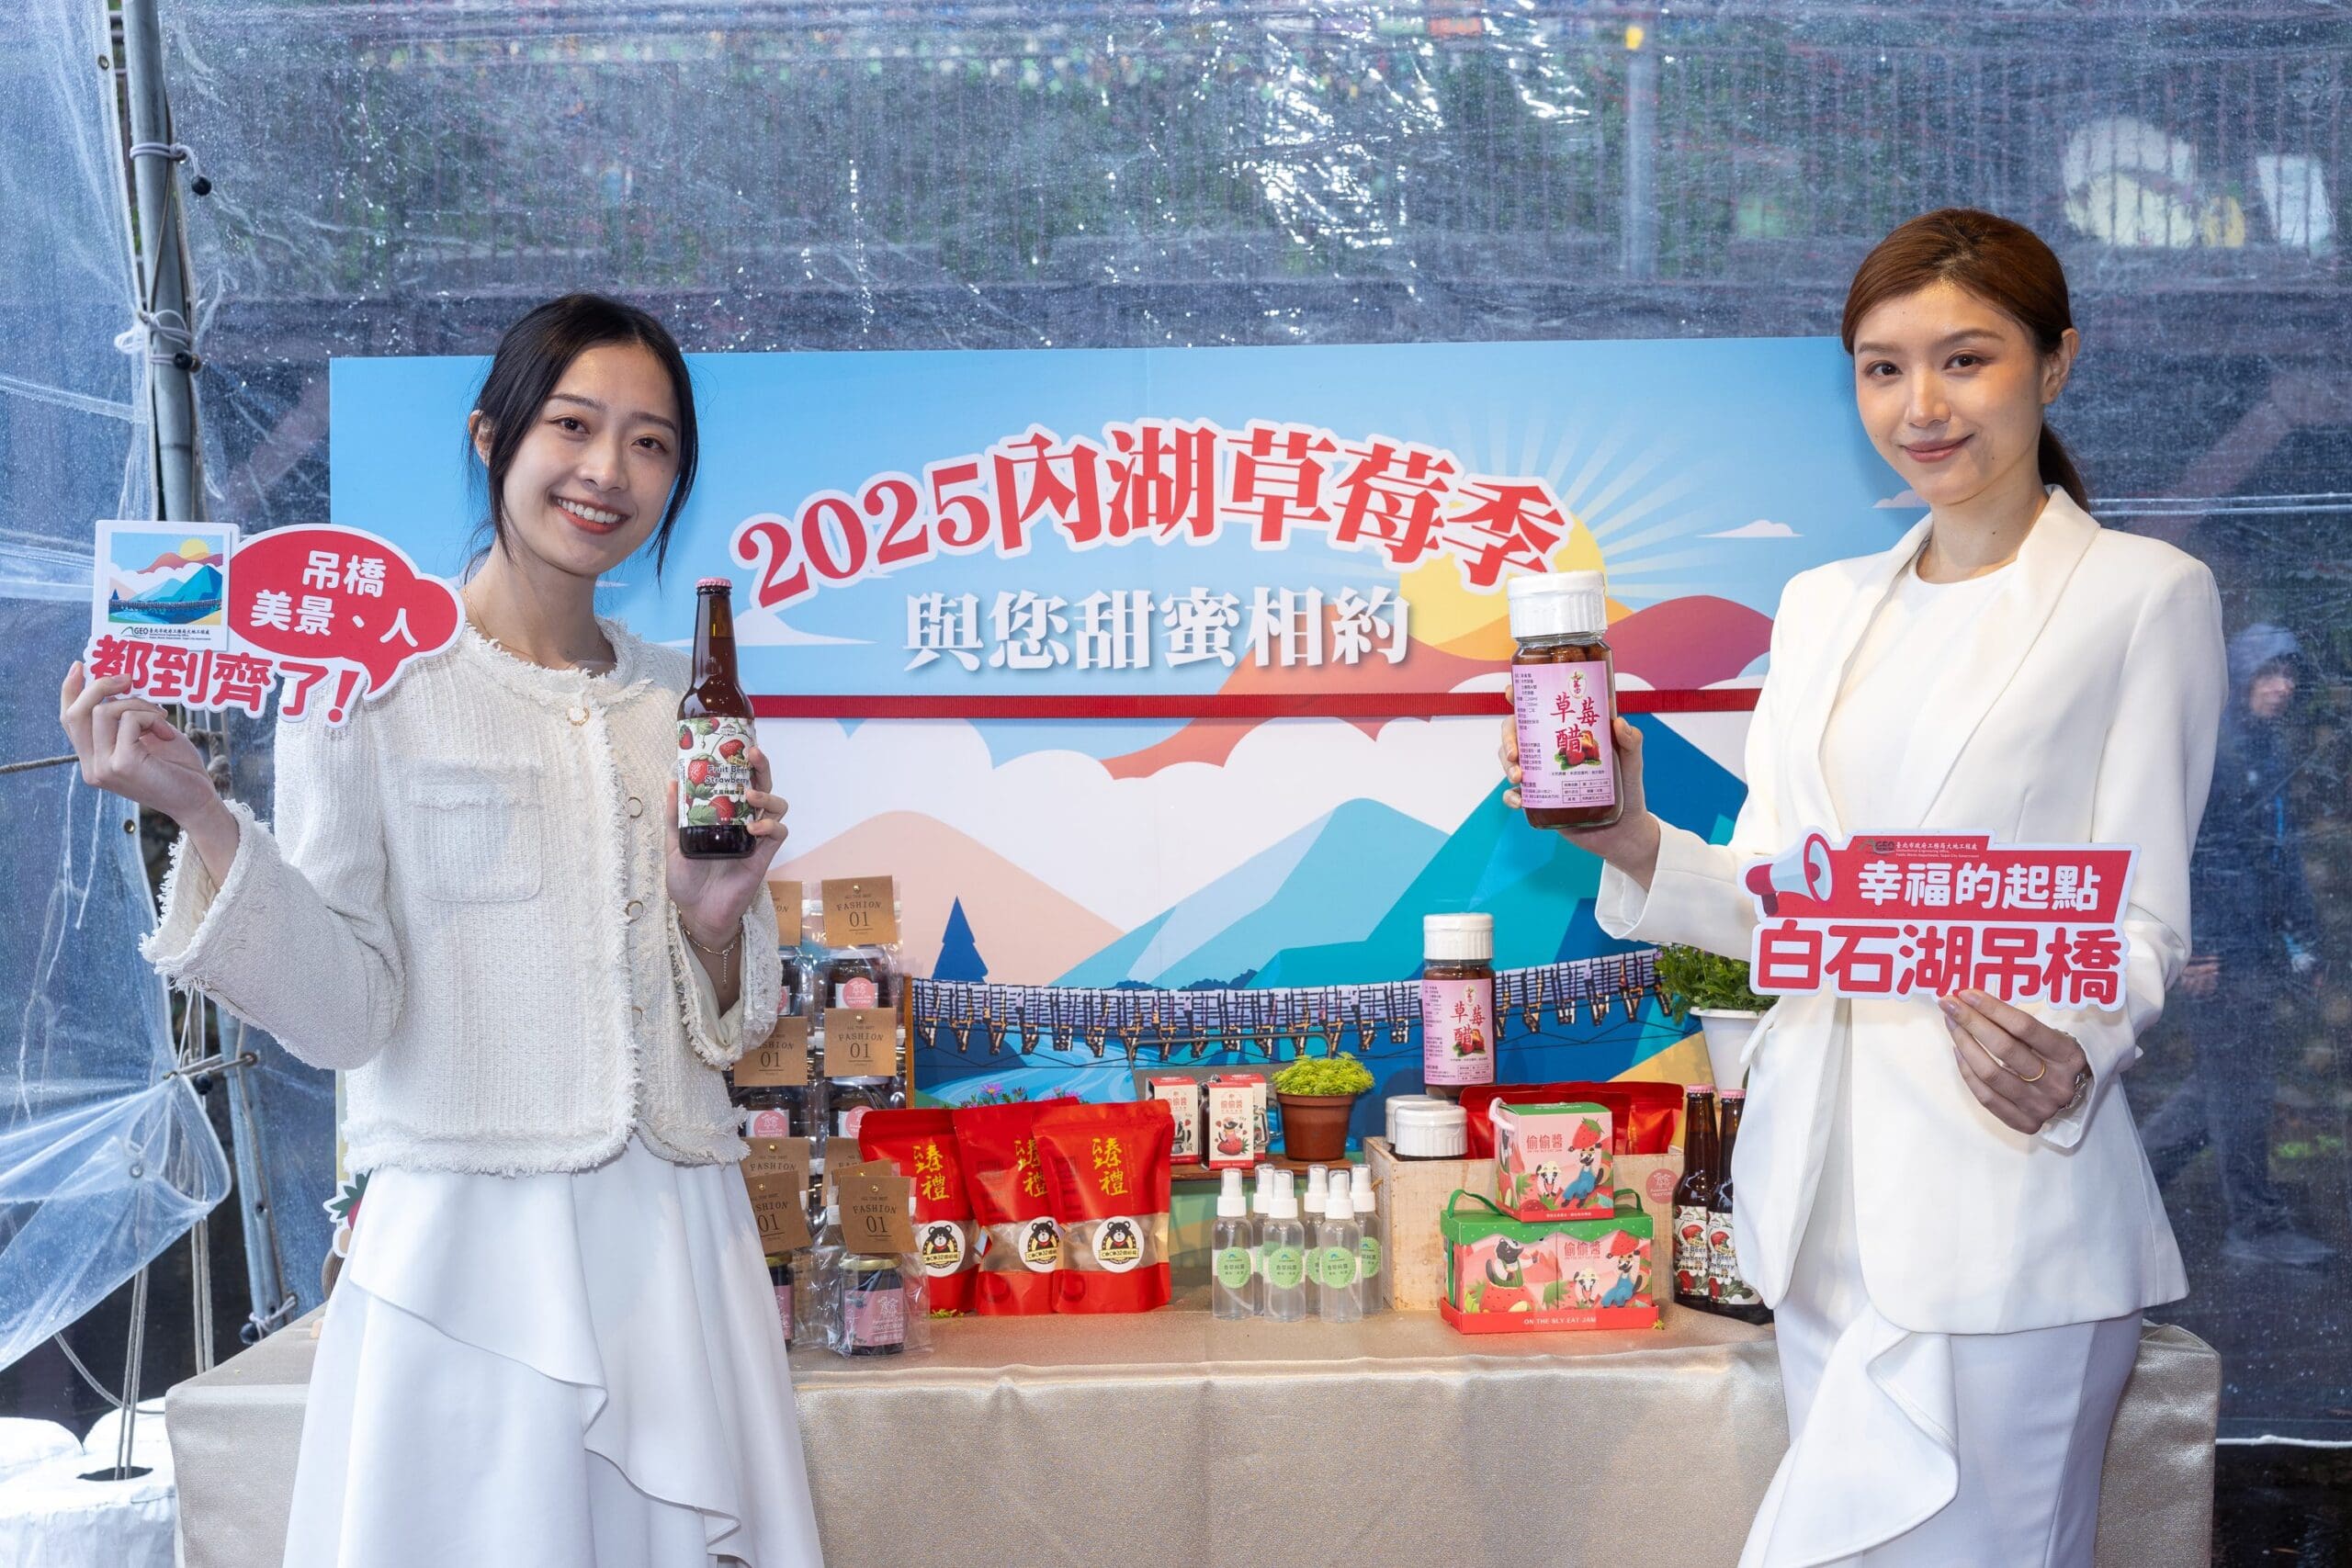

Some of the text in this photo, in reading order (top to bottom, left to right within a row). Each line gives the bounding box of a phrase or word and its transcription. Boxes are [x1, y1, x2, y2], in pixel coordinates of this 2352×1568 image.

[738, 426, 1566, 607] 2025內湖草莓季
[302, 550, 386, 598] 吊橋
[904, 587, 1409, 671] 與您甜蜜相約
[705, 776, 750, 785] Strawberry
[1858, 860, 2101, 911] 幸福的起點
[836, 901, 882, 911] FASHION
[849, 911, 871, 928] 01
[1758, 919, 2122, 1005] 白石湖吊橋
[838, 1032, 884, 1042] FASHION
[757, 1041, 795, 1050] SHION
[850, 1043, 871, 1059] 01
[761, 1051, 781, 1067] 01
[750, 1161, 797, 1171] FASHION
[755, 1201, 789, 1213] SHION
[853, 1204, 897, 1214] FASHION
[758, 1213, 781, 1232] 01
[866, 1215, 888, 1233] 01
